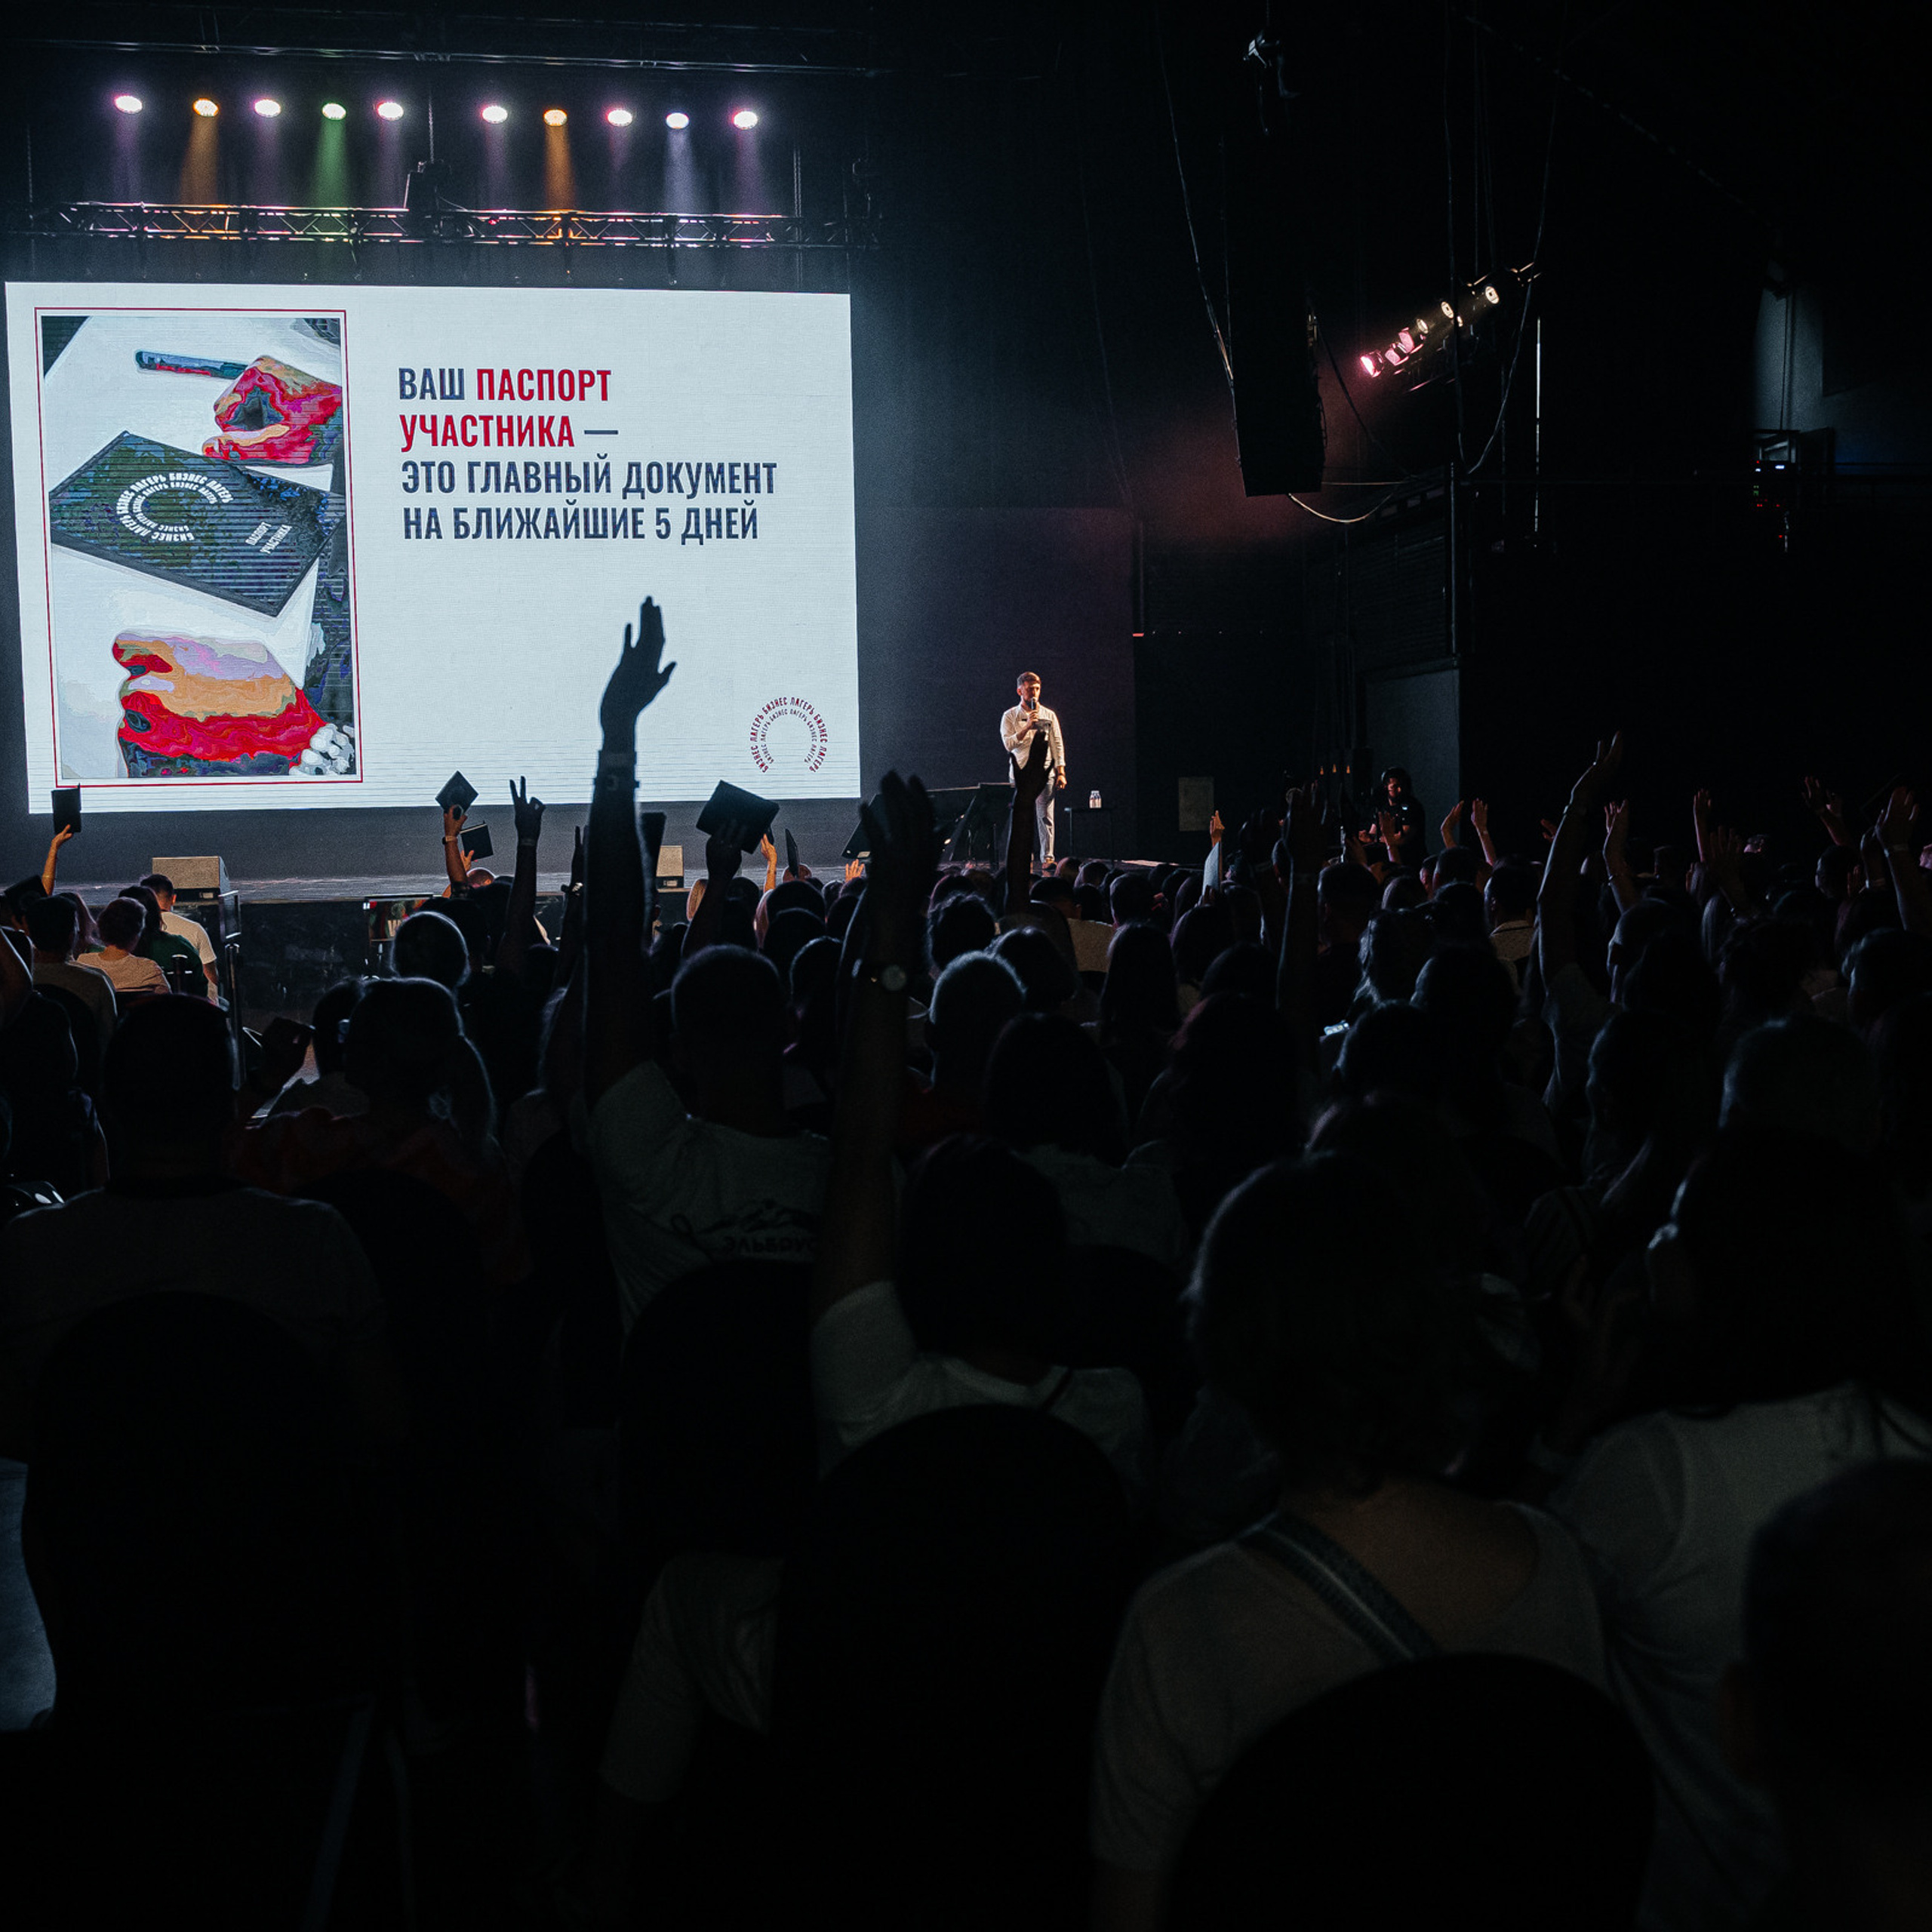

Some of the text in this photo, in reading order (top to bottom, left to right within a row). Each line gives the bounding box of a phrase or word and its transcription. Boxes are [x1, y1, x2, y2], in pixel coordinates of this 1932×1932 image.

[398, 368, 612, 401] ВАШ ПАСПОРТ
[399, 414, 575, 453] УЧАСТНИКА
[169, 472, 208, 484] БИЗНЕС
[401, 453, 777, 500] ЭТО ГЛАВНЫЙ ДОКУМЕНТ
[403, 499, 758, 545] НА БЛИЖАЙШИЕ 5 ДНЕЙ
[761, 696, 788, 715] БИЗНЕС
[789, 696, 815, 715] ЛАГЕРЬ
[814, 713, 828, 743] БИЗНЕС
